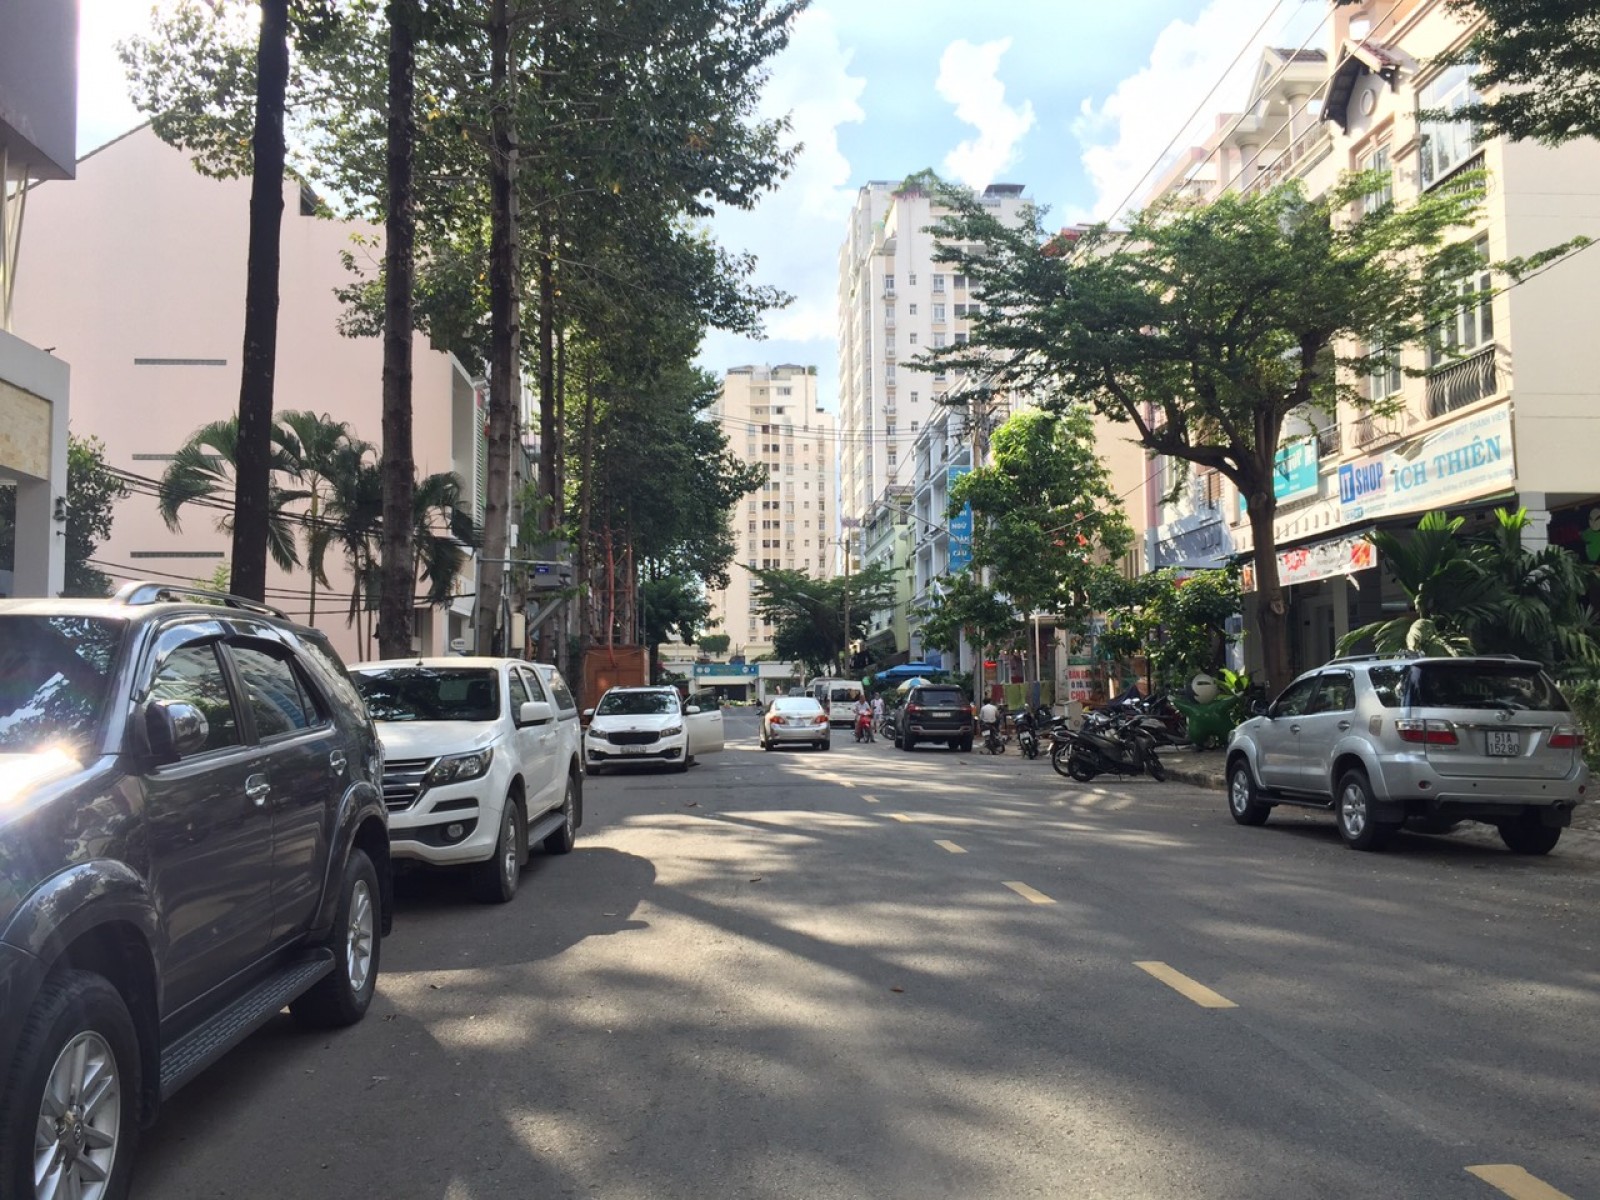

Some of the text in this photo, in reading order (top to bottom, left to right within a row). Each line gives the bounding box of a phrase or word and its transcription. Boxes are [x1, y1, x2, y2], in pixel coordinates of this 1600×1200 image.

[1434, 435, 1501, 480] THIÊN
[1355, 461, 1384, 496] SHOP
[1494, 733, 1512, 744] 51A
